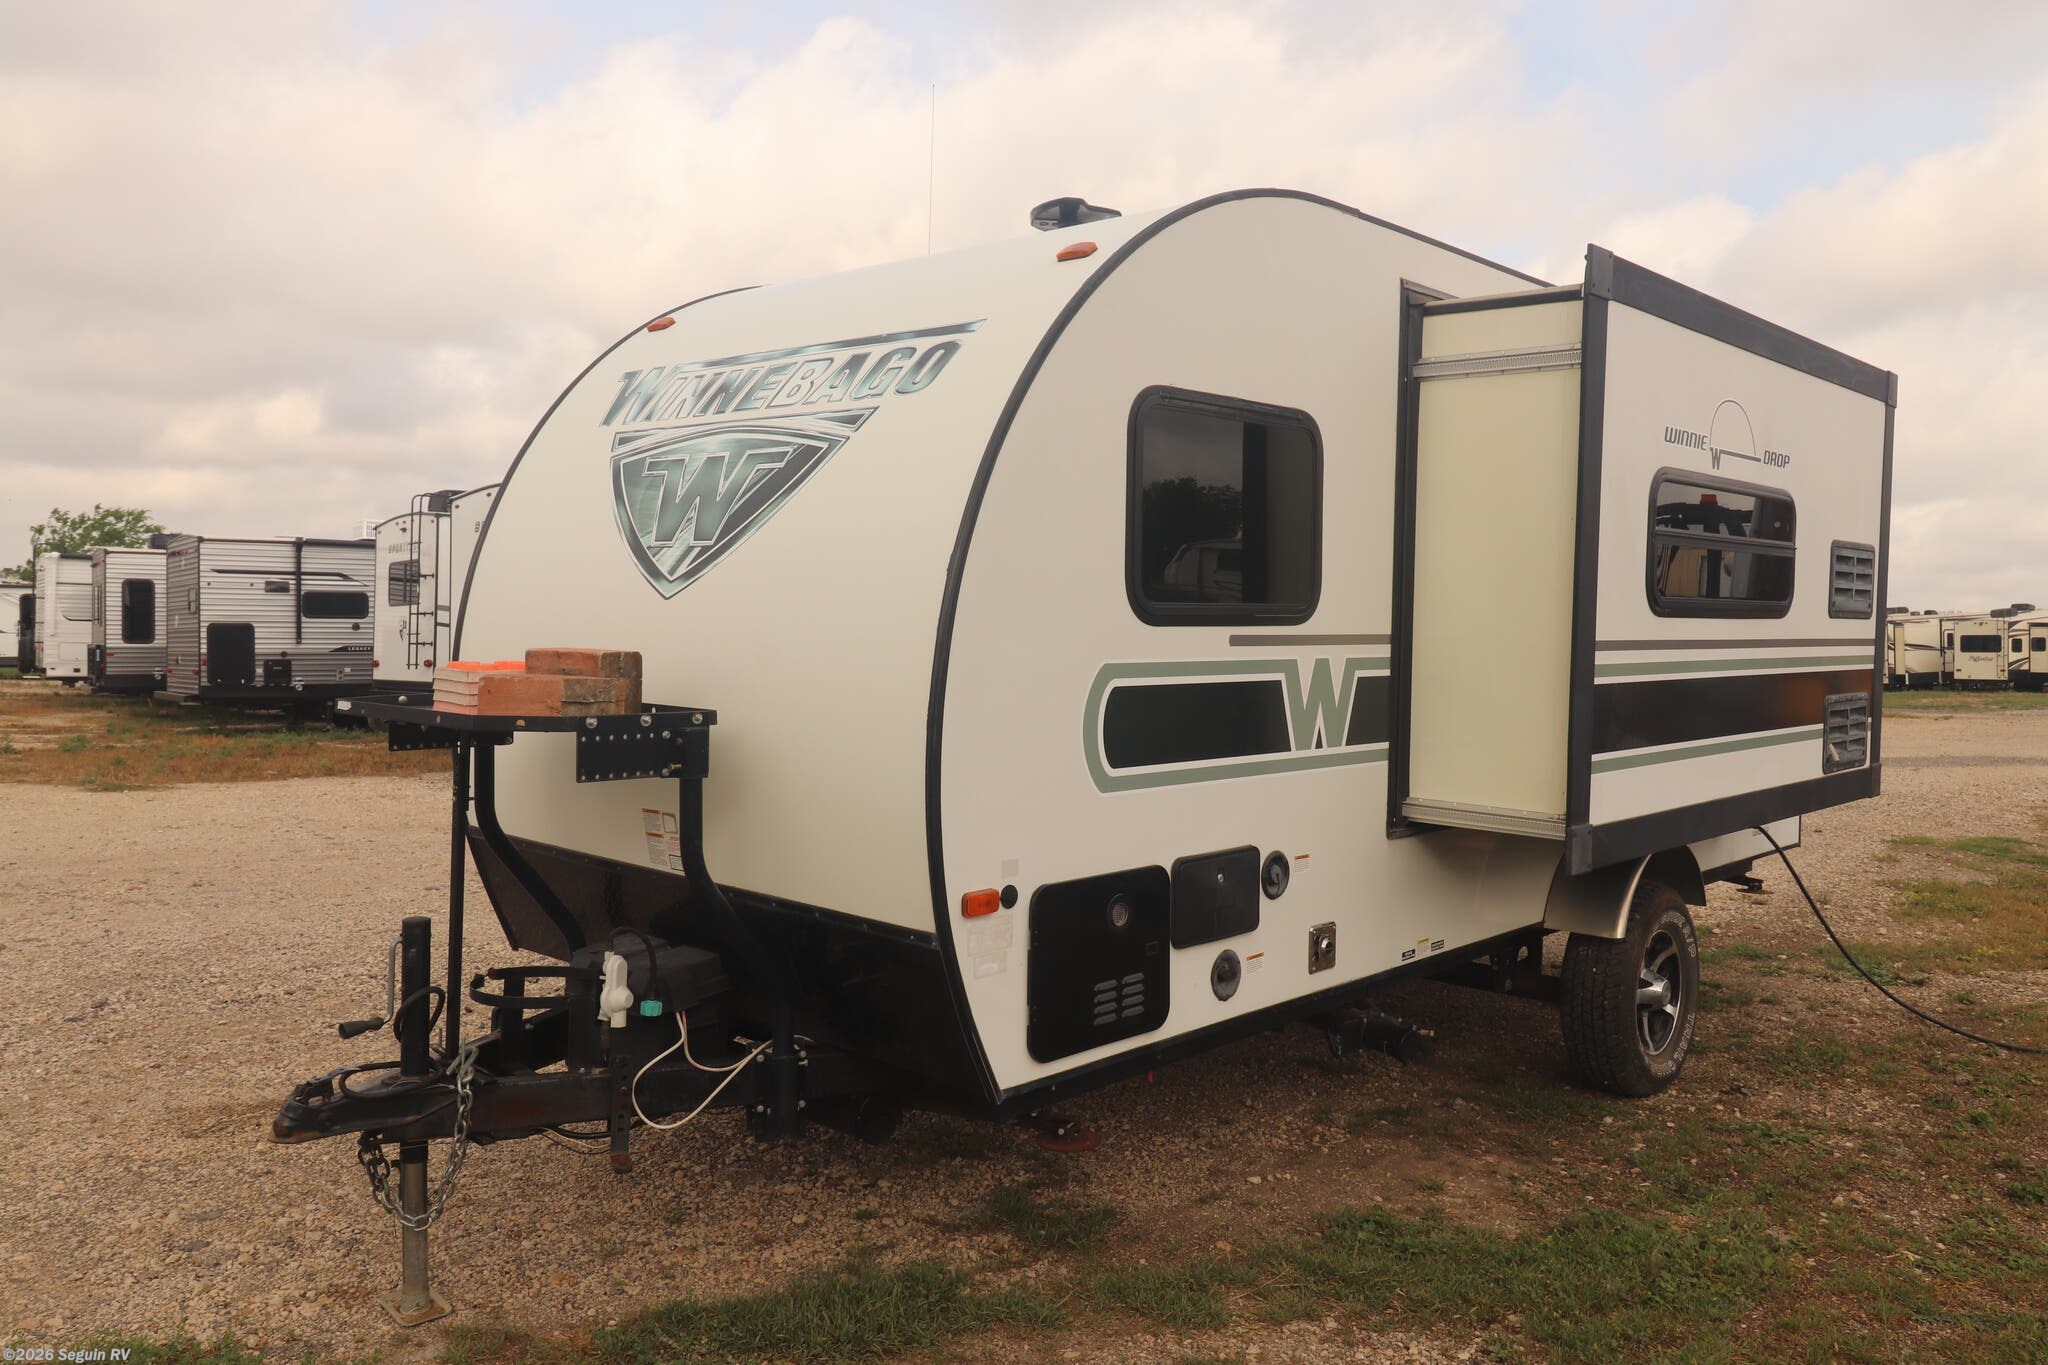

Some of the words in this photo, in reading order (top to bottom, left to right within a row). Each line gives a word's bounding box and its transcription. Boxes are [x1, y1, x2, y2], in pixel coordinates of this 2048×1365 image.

[600, 339, 962, 427] WINNEBAGO
[1664, 426, 1708, 451] WINNIE
[1763, 450, 1790, 469] DROP
[642, 443, 797, 547] W
